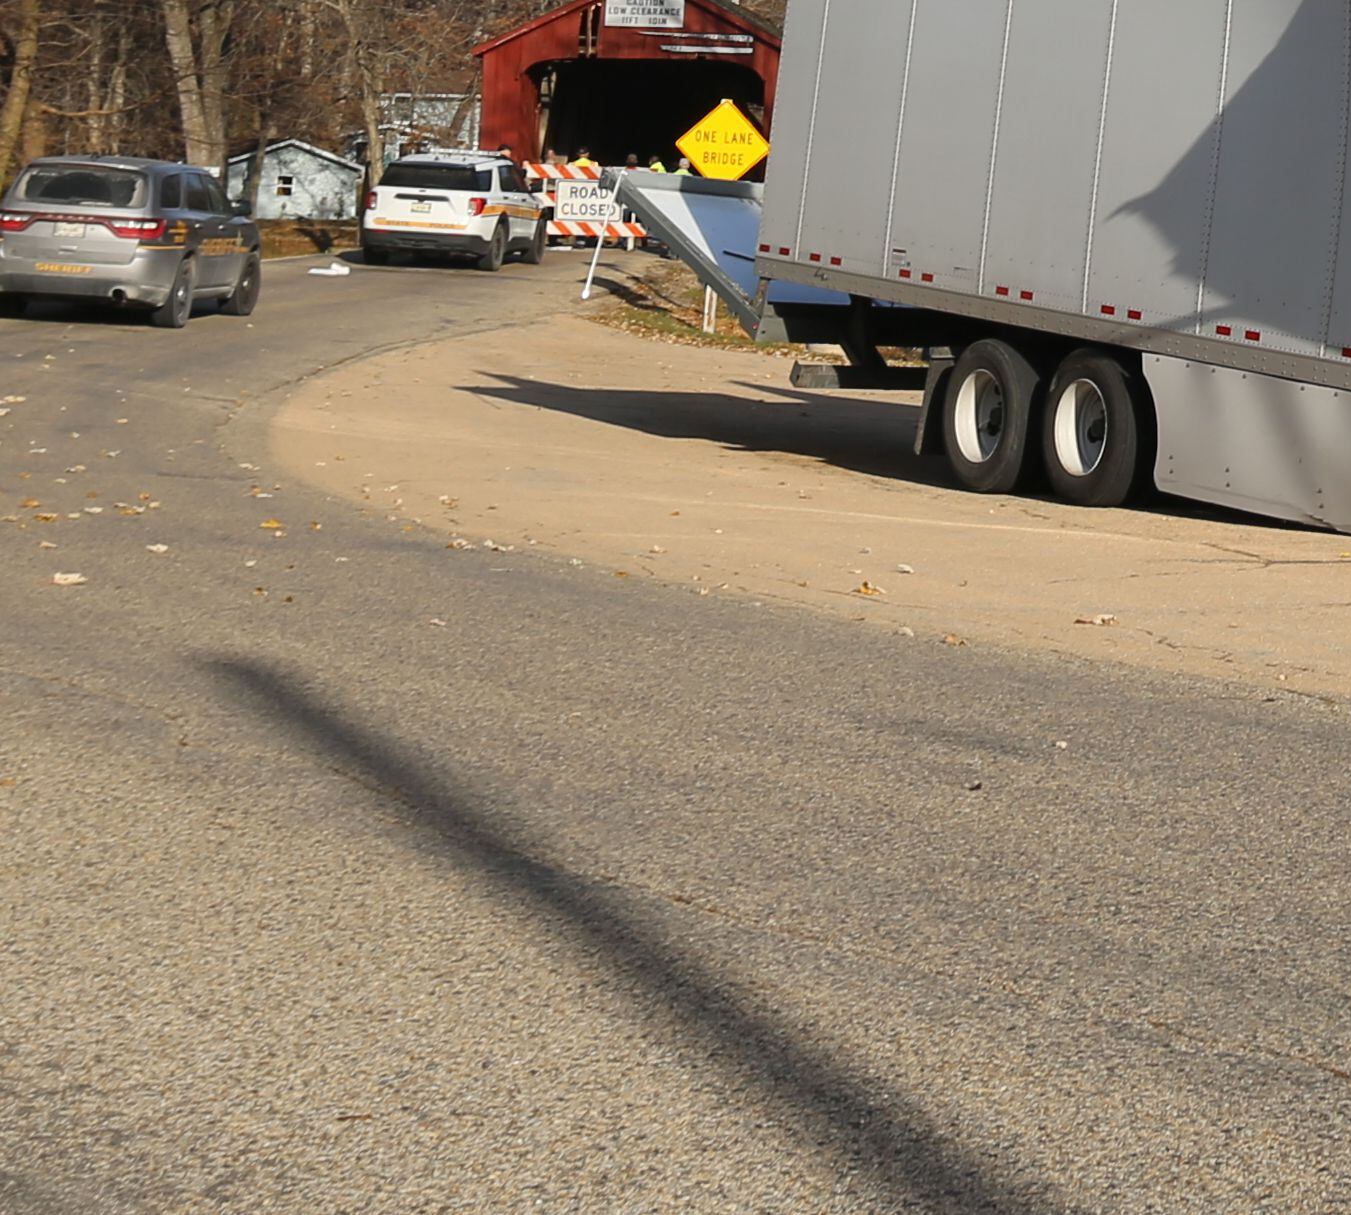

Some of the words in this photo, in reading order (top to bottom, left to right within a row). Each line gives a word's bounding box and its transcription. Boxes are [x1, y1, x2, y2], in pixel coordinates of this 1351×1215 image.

[608, 7, 626, 15] LOW
[630, 7, 681, 16] CLEARANCE
[695, 129, 717, 143] ONE
[724, 131, 754, 145] LANE
[702, 151, 744, 165] BRIDGE
[570, 186, 609, 199] ROAD
[561, 203, 616, 216] CLOSED
